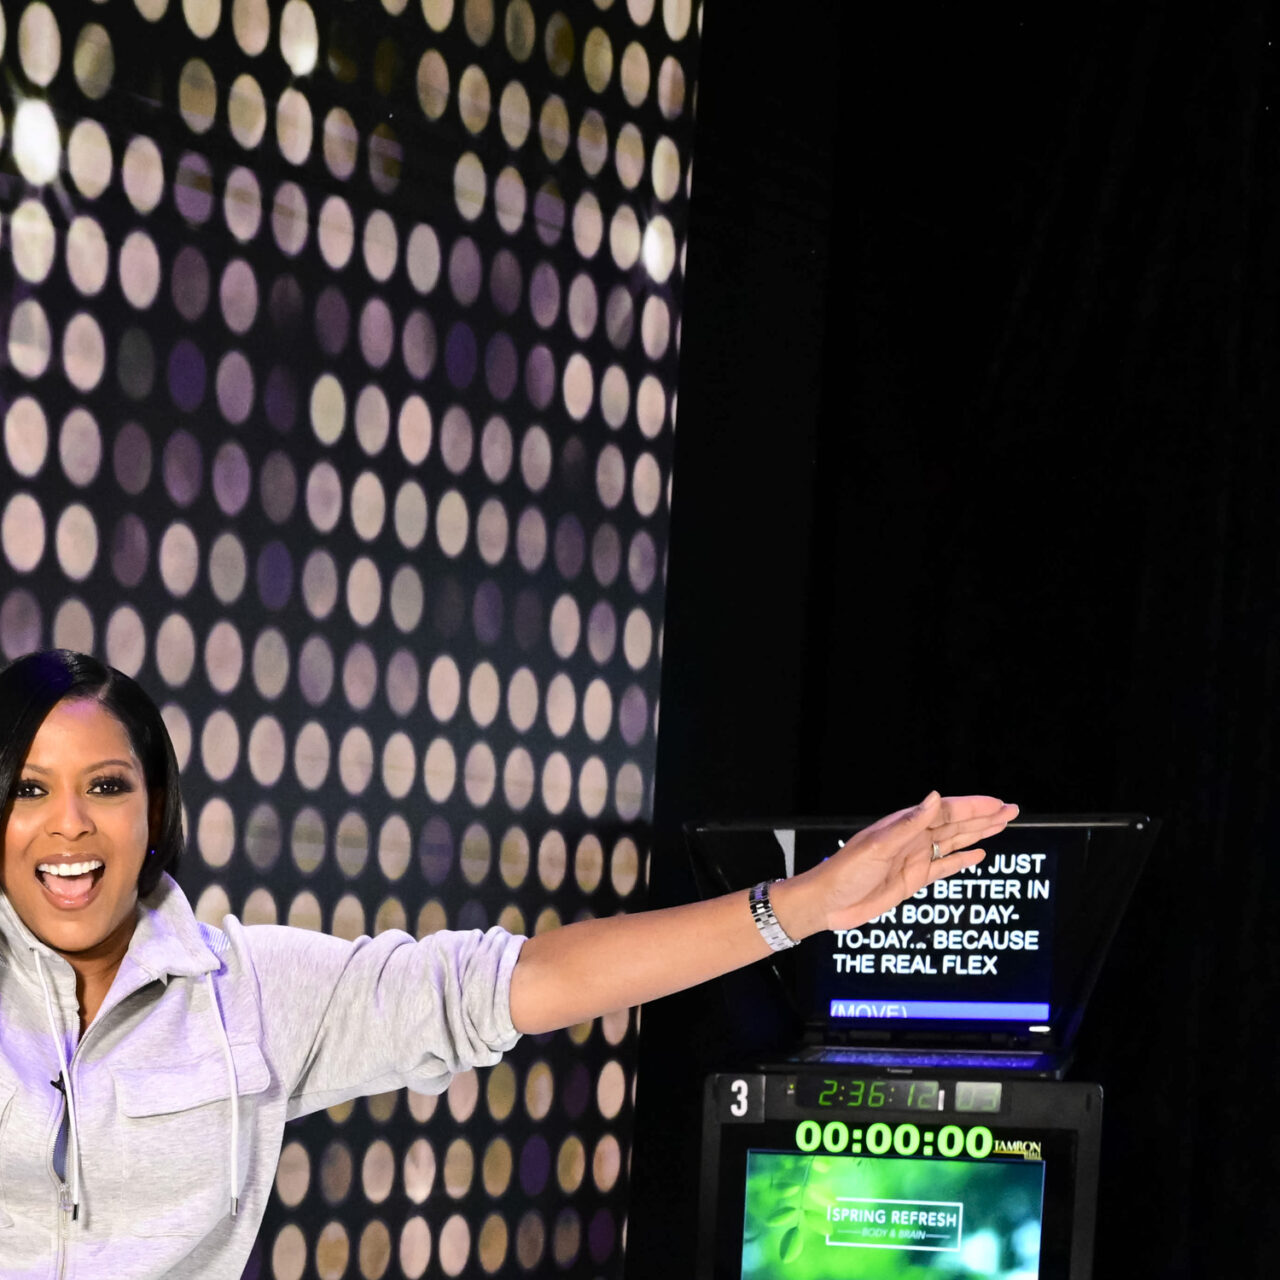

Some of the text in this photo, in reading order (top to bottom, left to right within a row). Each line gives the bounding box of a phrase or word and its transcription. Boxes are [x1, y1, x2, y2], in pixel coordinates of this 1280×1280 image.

[988, 854, 1046, 874] JUST
[933, 879, 1021, 899] BETTER
[1027, 879, 1050, 900] IN
[902, 904, 965, 924] BODY
[970, 905, 1020, 925] DAY-
[933, 930, 1040, 950] BECAUSE
[832, 953, 998, 975] THE REAL FLEX
[730, 1079, 749, 1117] 3
[795, 1119, 993, 1159] 00:00:00
[832, 1207, 957, 1227] SPRING REFRESH
